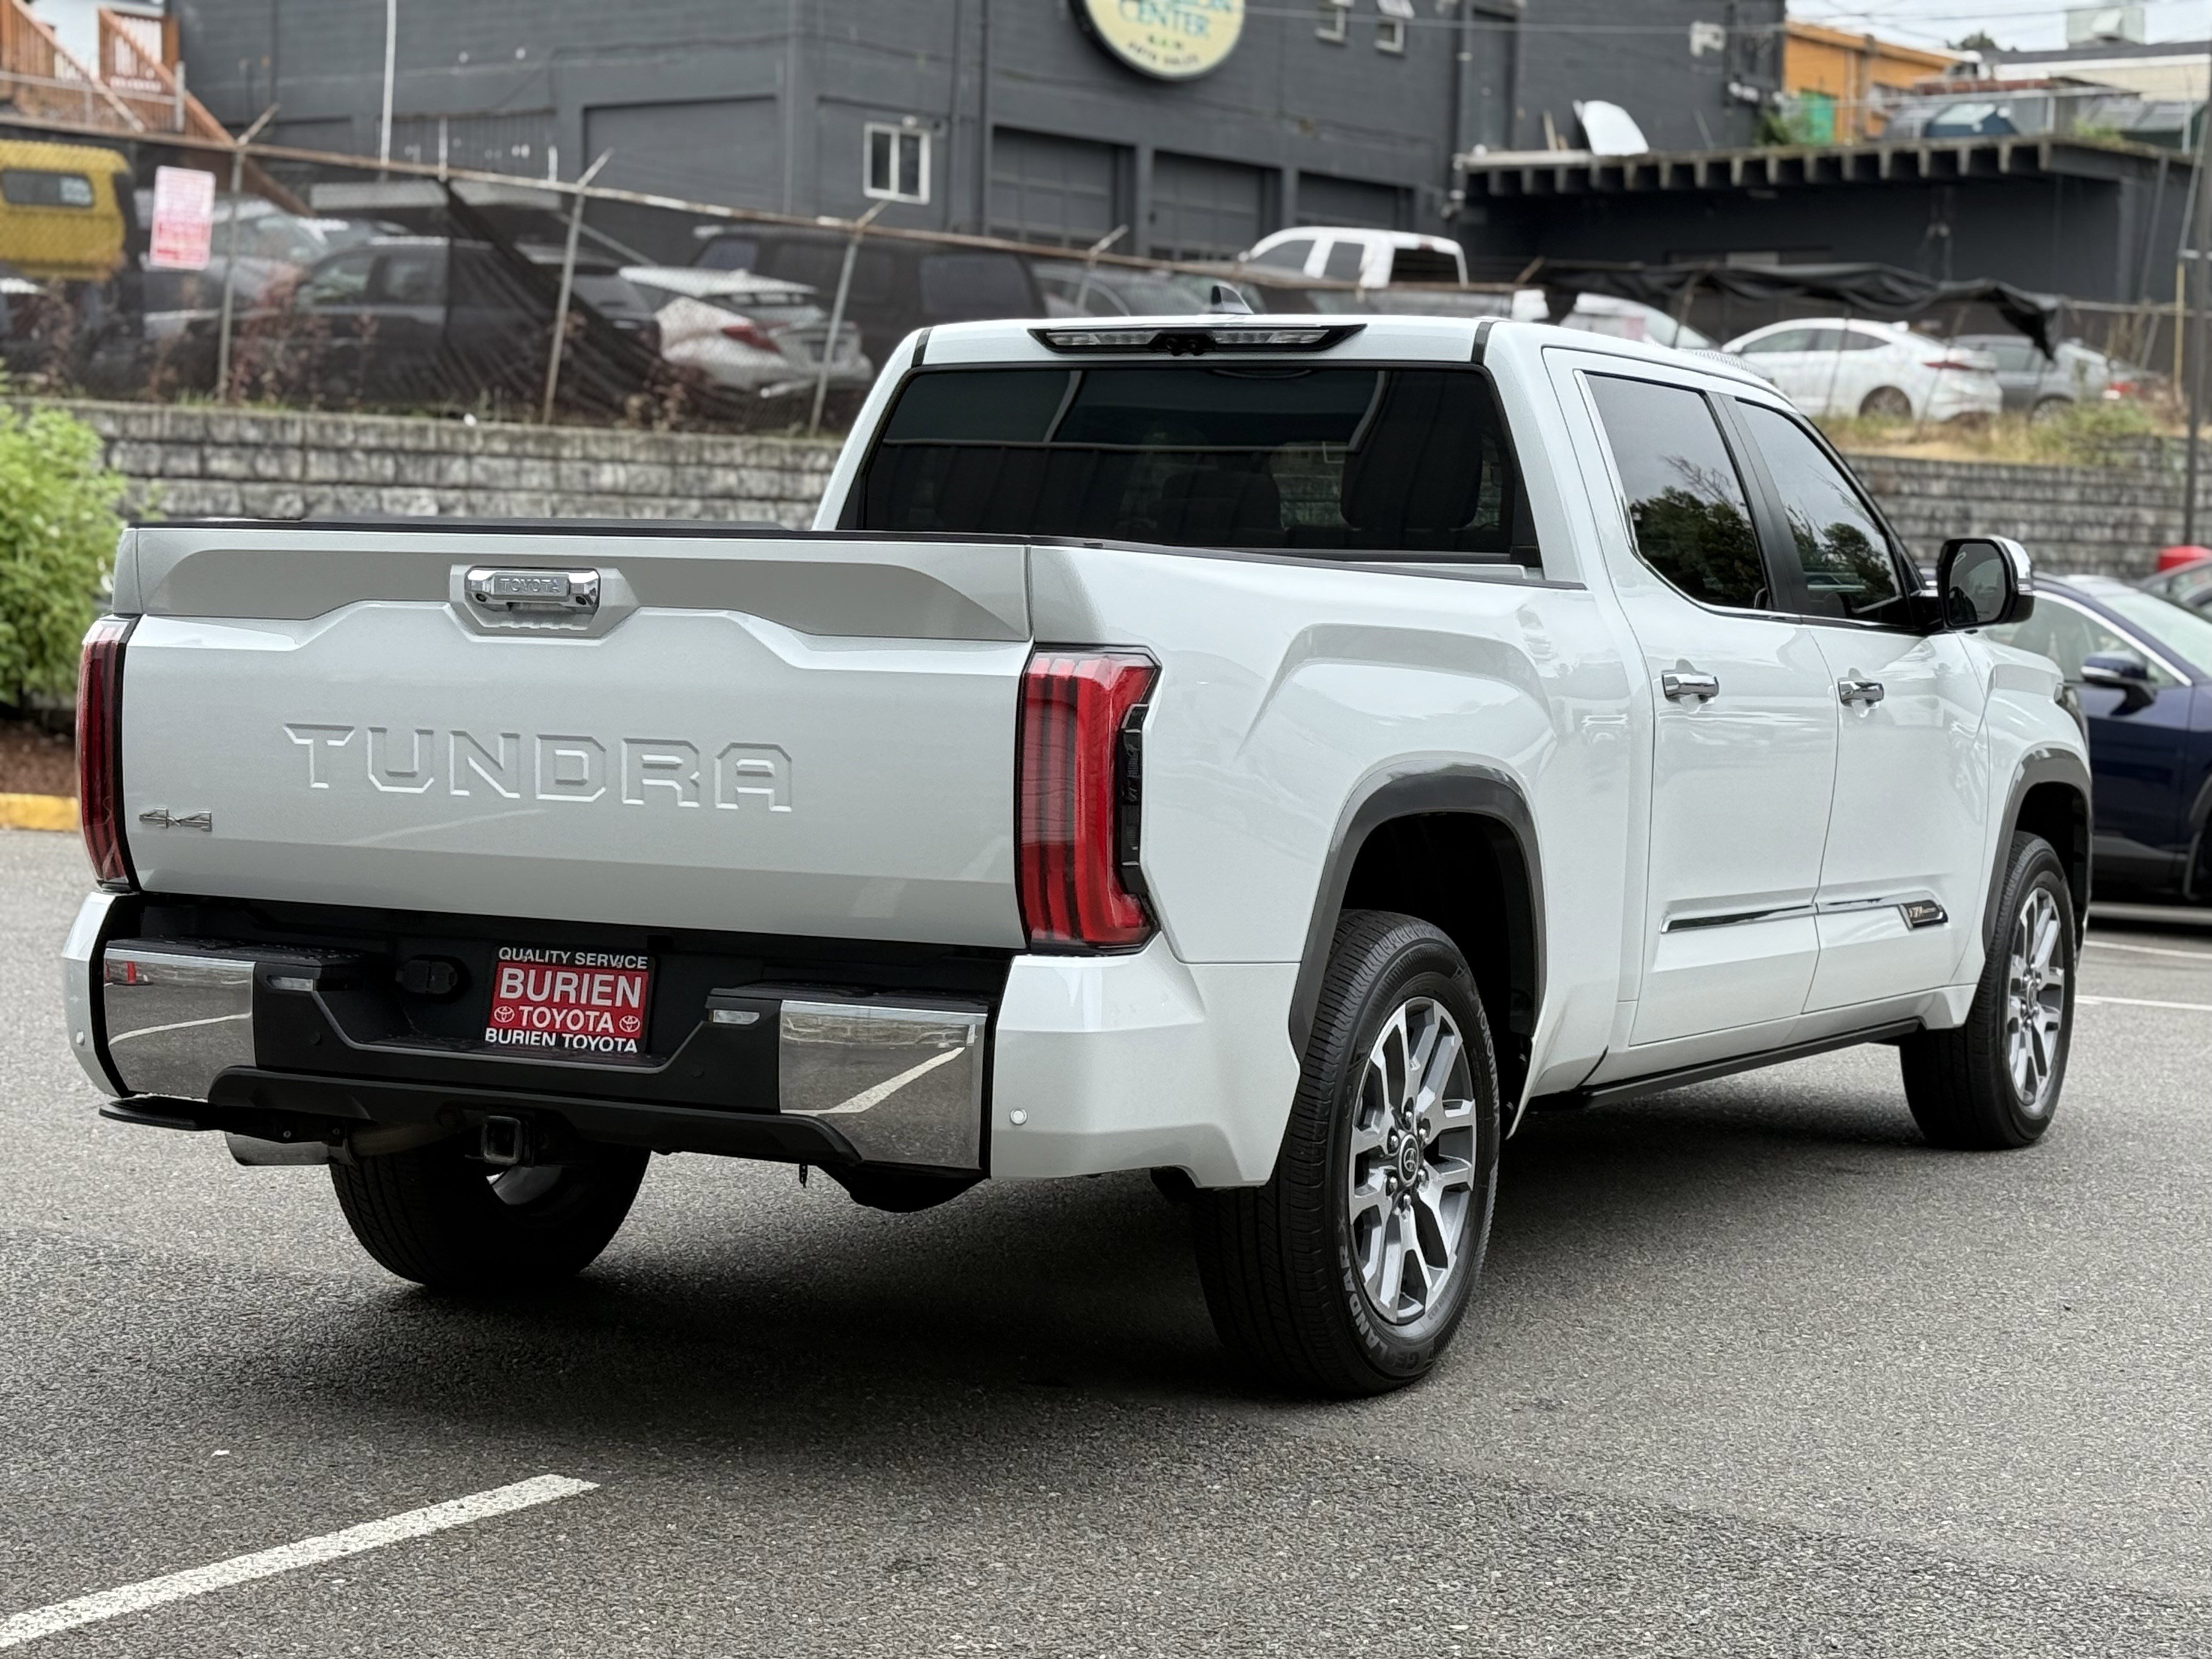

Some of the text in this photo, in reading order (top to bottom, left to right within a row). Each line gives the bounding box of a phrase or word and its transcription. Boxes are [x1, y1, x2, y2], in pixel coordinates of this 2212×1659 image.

[1120, 0, 1210, 37] CENTER
[500, 578, 561, 593] TOYOTA
[283, 723, 792, 812] TUNDRA
[499, 947, 648, 969] QUALITY SERVICE
[499, 968, 641, 1008] BURIEN
[518, 1005, 614, 1033] TOYOTA
[485, 1028, 637, 1053] BURIEN TOYOTA
